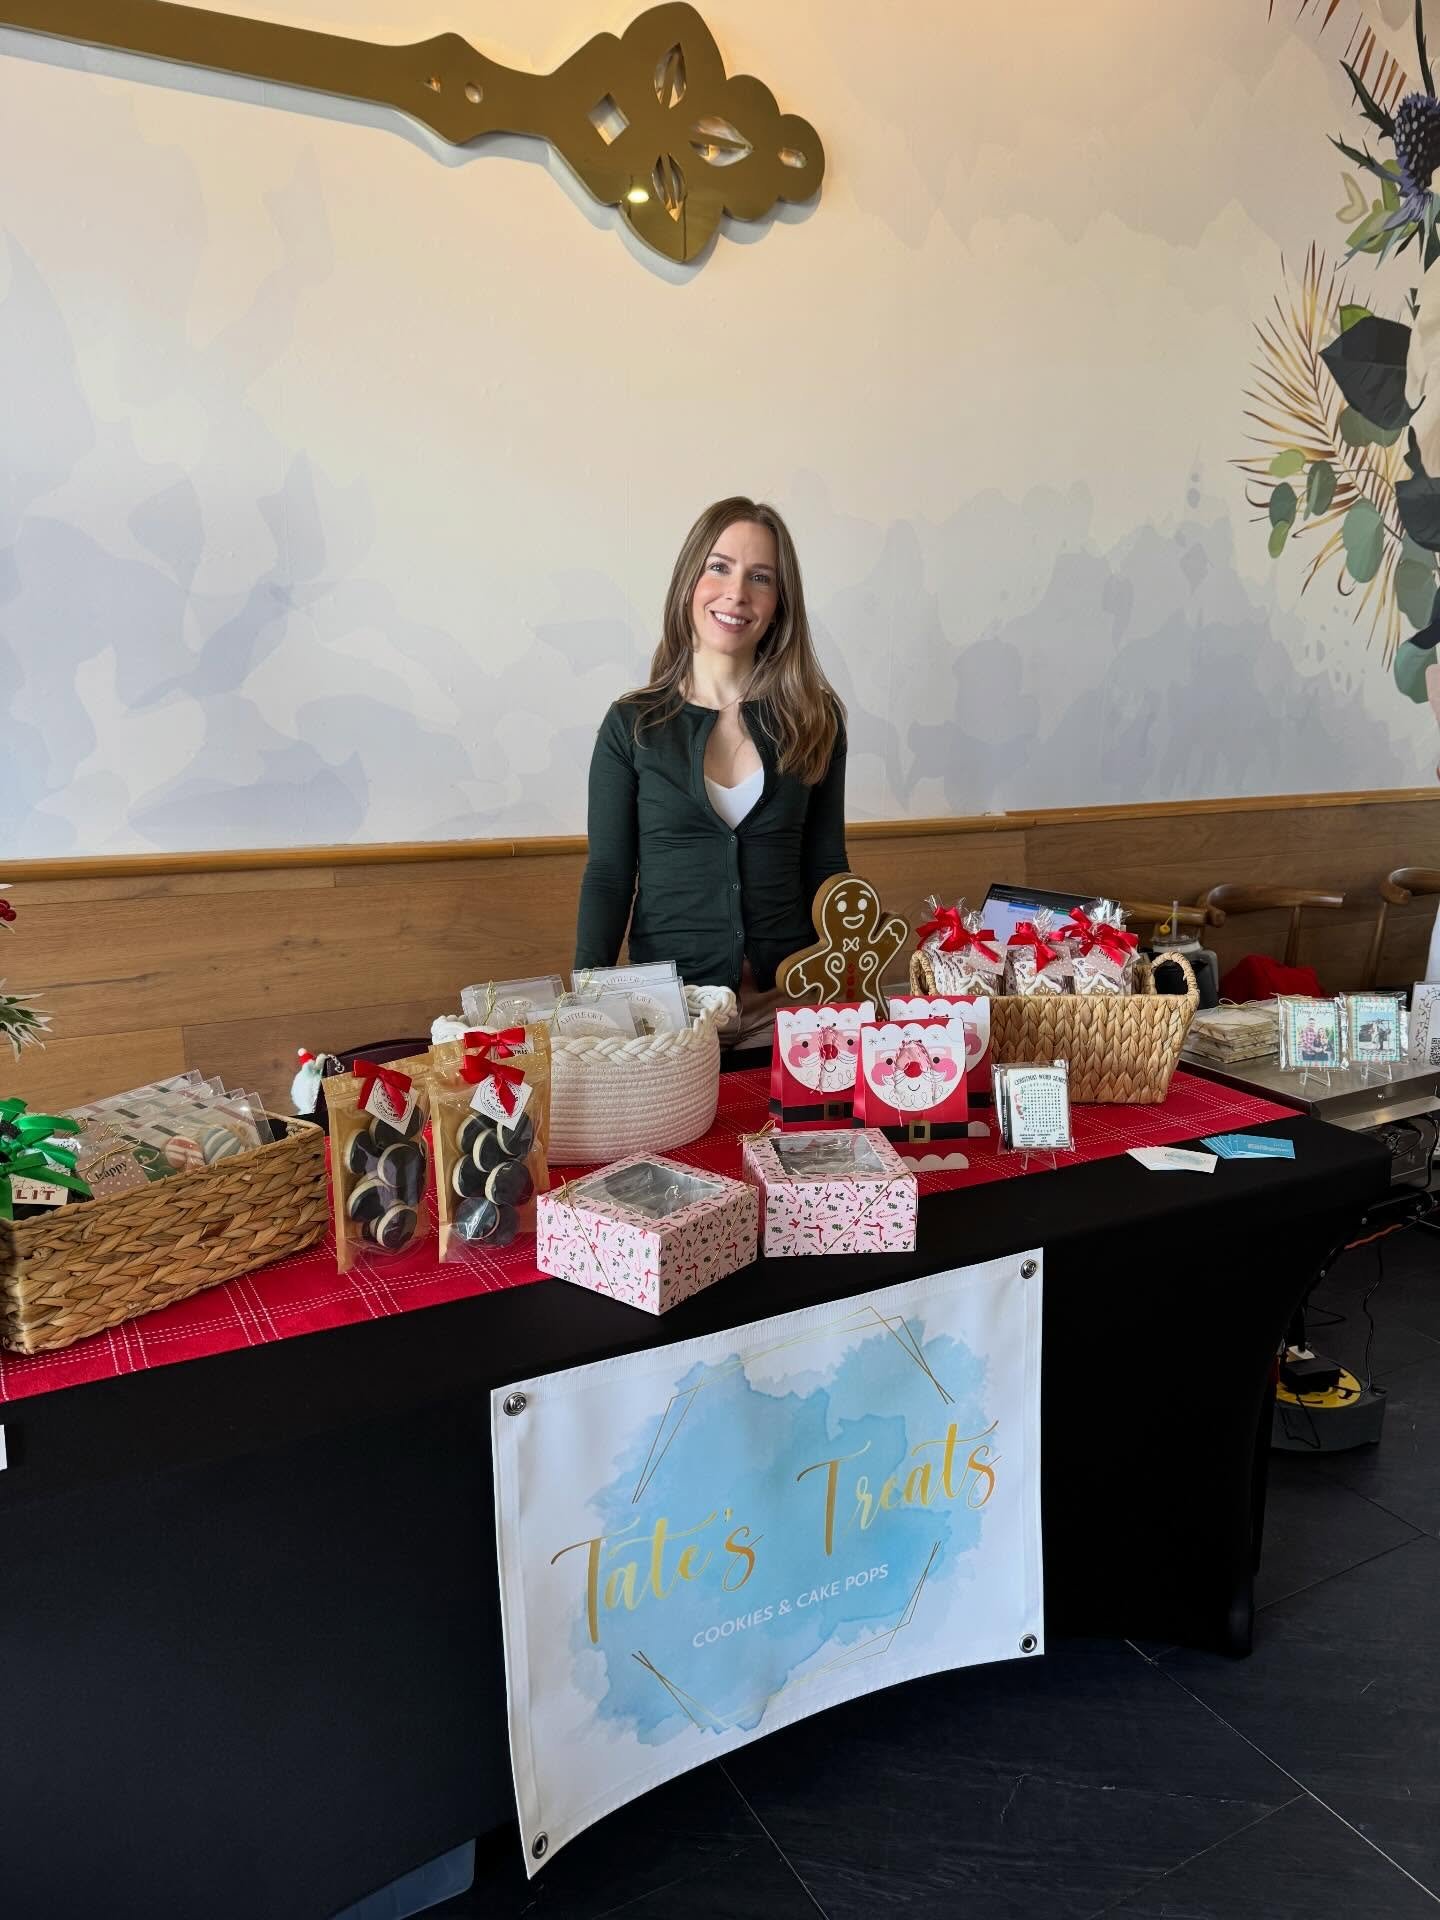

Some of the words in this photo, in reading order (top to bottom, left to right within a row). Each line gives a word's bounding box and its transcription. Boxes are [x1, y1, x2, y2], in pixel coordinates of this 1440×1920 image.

[15, 1189, 56, 1201] LIT
[551, 1508, 764, 1645] Tate's
[797, 1420, 1002, 1557] Treats
[692, 1605, 775, 1649] COOKIES
[777, 1599, 793, 1617] &
[796, 1580, 841, 1609] CAKE
[844, 1563, 889, 1592] POPS
